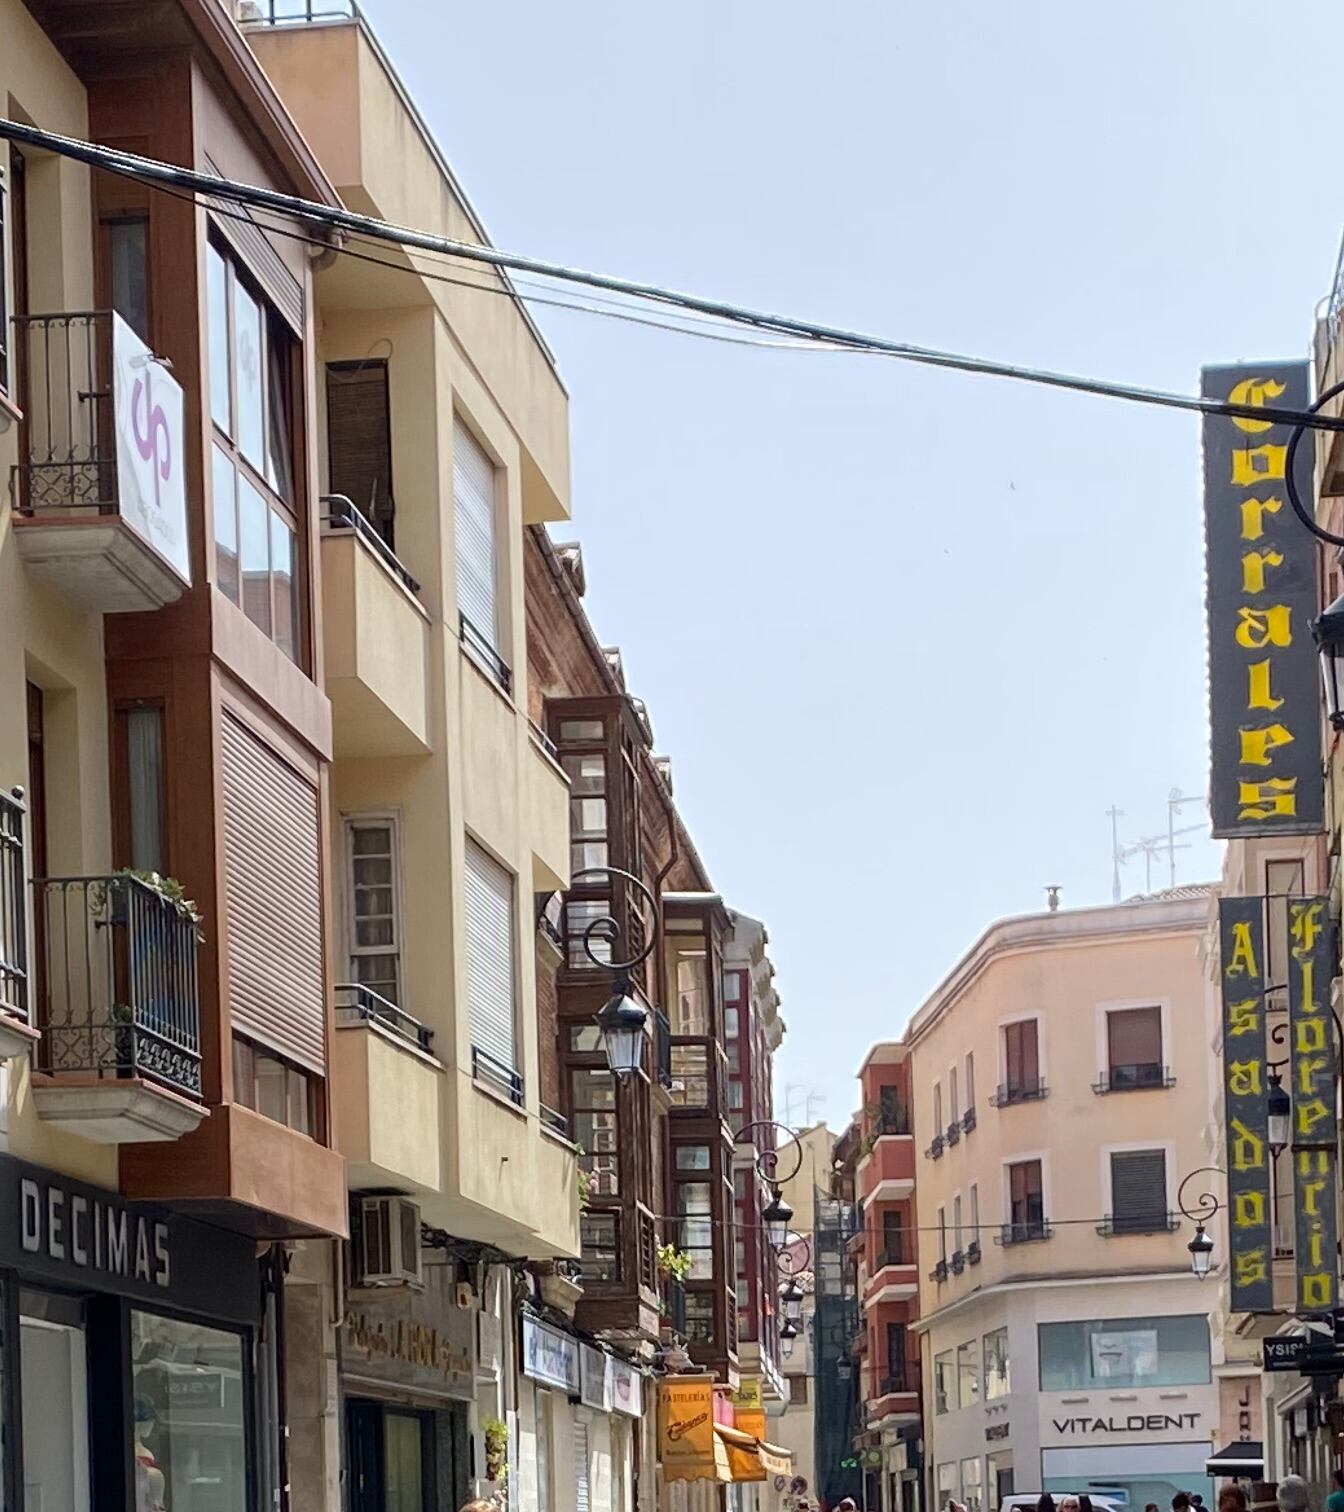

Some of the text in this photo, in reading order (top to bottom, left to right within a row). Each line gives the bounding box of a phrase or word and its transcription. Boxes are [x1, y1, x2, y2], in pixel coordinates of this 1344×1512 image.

[1230, 377, 1298, 821] Corrales
[1226, 921, 1267, 1285] Asados
[21, 1178, 170, 1287] DECIMAS
[1052, 1413, 1201, 1434] VITALDENT
